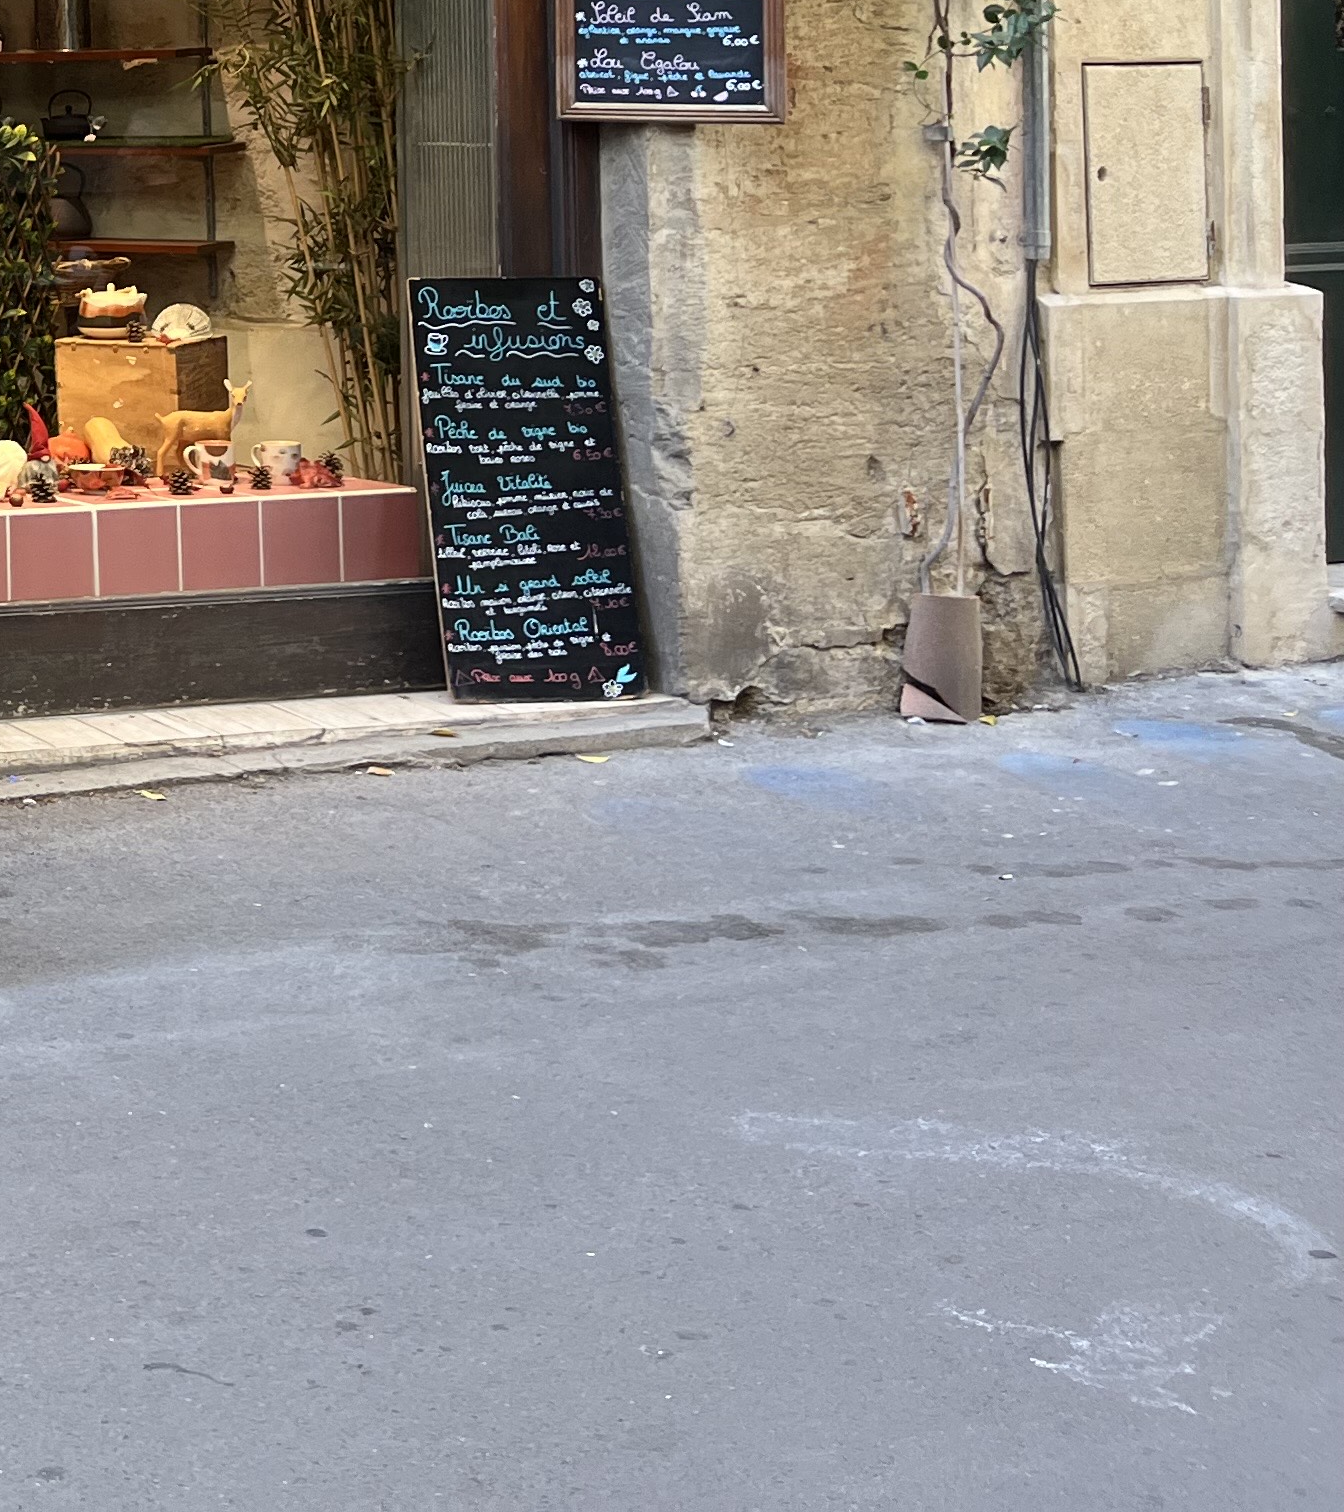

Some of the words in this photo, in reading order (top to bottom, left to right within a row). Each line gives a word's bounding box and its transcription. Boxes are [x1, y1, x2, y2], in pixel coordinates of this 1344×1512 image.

[590, 1, 636, 24] Soleil
[650, 7, 675, 22] de
[687, 3, 733, 23] Siam
[590, 48, 624, 68] Lou
[640, 51, 700, 75] Cigalou
[537, 291, 567, 321] et
[464, 327, 585, 361] infusions
[430, 363, 485, 385] Tisane
[501, 374, 521, 386] du
[531, 375, 564, 387] sud
[576, 375, 596, 387] bio
[435, 415, 478, 439] Pêche
[488, 427, 507, 440] de
[567, 422, 588, 434] bio
[444, 524, 492, 546] Tisane
[499, 525, 540, 544] Bali
[454, 575, 485, 595] Un
[494, 581, 509, 593] si
[519, 574, 561, 598] grand
[572, 569, 612, 586] soleil
[523, 617, 589, 638] Oriental
